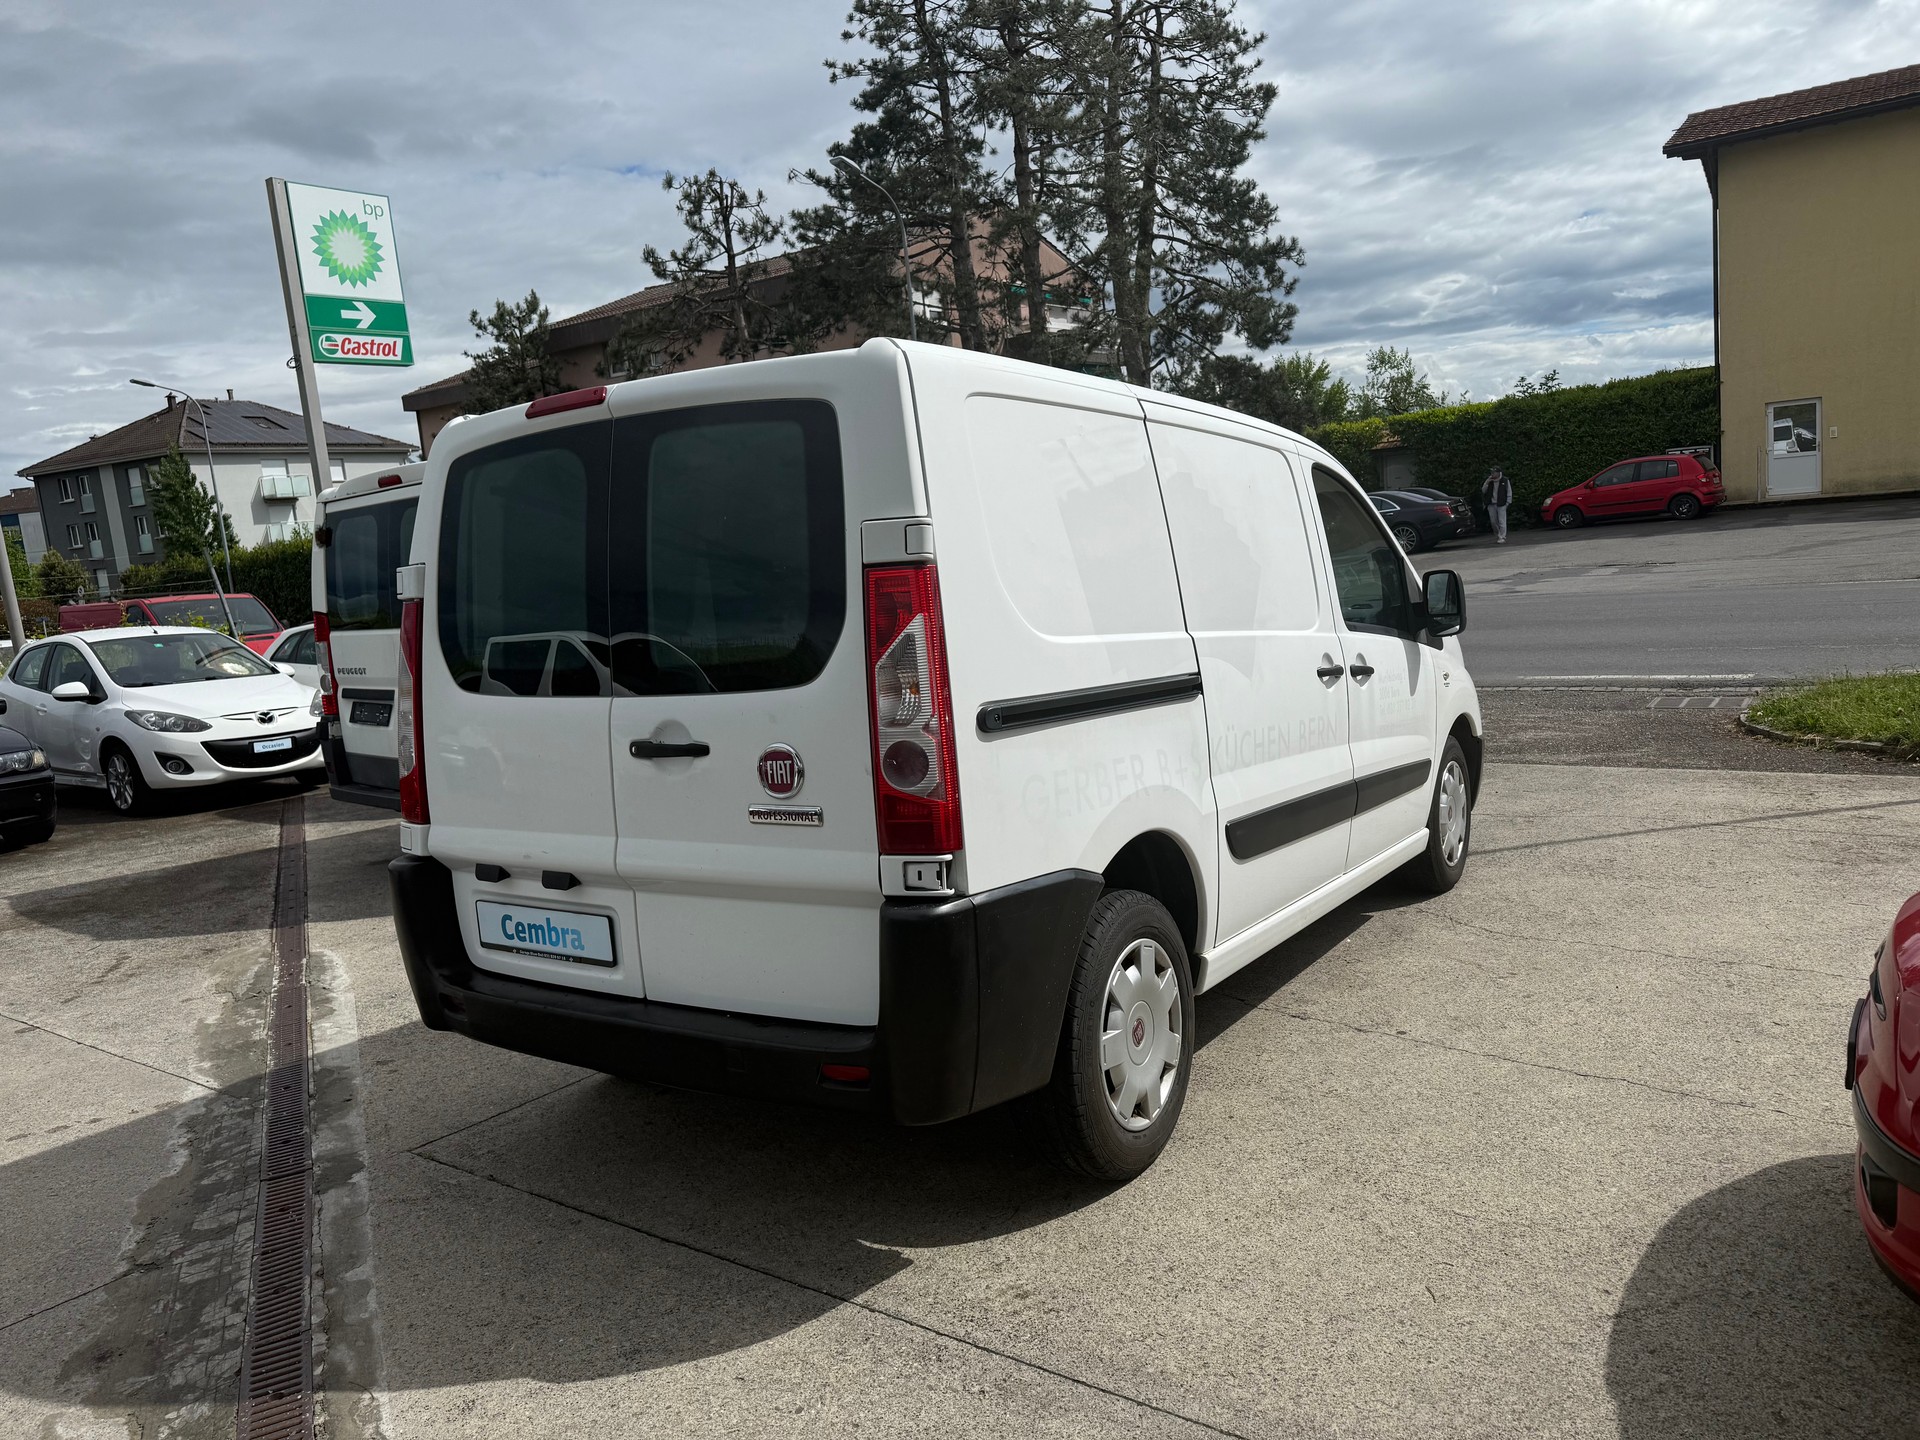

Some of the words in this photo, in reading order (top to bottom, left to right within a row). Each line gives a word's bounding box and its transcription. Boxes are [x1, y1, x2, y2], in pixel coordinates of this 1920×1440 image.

[362, 199, 384, 220] bp
[340, 337, 398, 357] Castrol
[337, 667, 367, 675] PEUGEOT
[766, 760, 792, 784] FIAT
[1022, 754, 1150, 825] GERBER
[1211, 721, 1290, 775] KÜCHEN
[1299, 711, 1338, 753] BERN
[752, 809, 816, 823] PROFESSIONAL
[501, 913, 585, 951] Cembra
